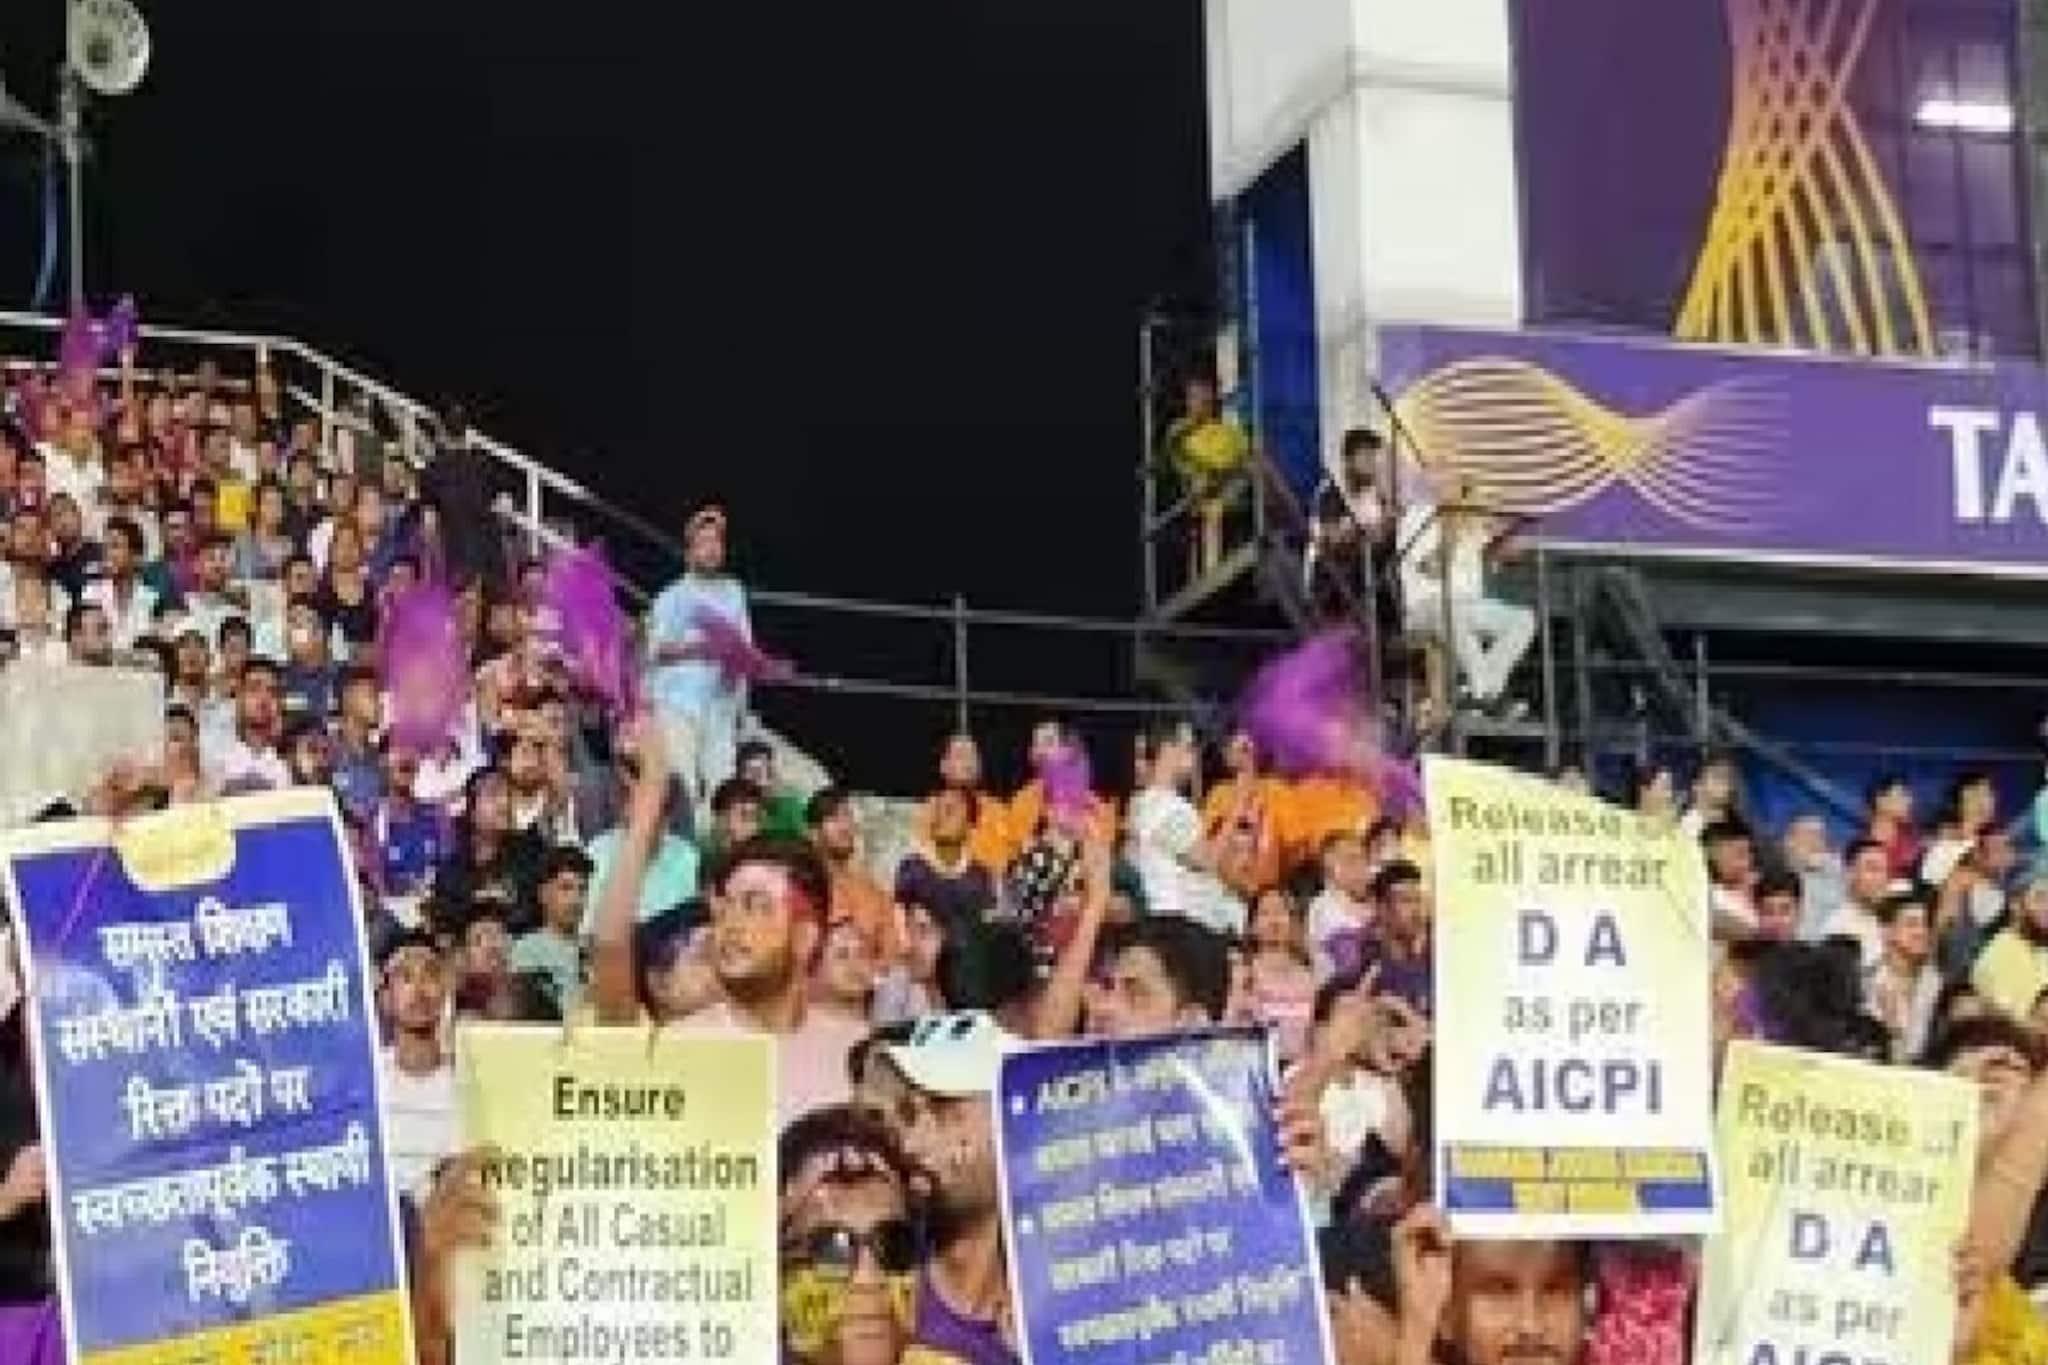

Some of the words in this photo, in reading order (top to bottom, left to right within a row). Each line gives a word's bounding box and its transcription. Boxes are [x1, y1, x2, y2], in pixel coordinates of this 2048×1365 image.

[1928, 406, 2048, 521] TA
[1449, 796, 1621, 839] Release
[1471, 841, 1523, 885] all
[1538, 852, 1668, 890] arrear
[1519, 909, 1559, 967] D
[1583, 911, 1627, 967] A
[1503, 997, 1553, 1034] as
[1568, 1000, 1644, 1046] per
[552, 1076, 686, 1120] Ensure
[1482, 1058, 1663, 1114] AICPI
[1739, 1083, 1912, 1148] Release
[1748, 1140, 1801, 1185] all
[511, 1201, 543, 1247] of
[557, 1205, 600, 1247] All
[609, 1201, 726, 1247] Casual
[1788, 1210, 1830, 1258] D
[1855, 1219, 1895, 1276] A
[482, 1262, 548, 1301] and
[557, 1257, 752, 1304] Contractual
[502, 1312, 691, 1365] Employees
[698, 1319, 737, 1358] to
[1767, 1290, 1819, 1324] as
[1833, 1298, 1905, 1340] per
